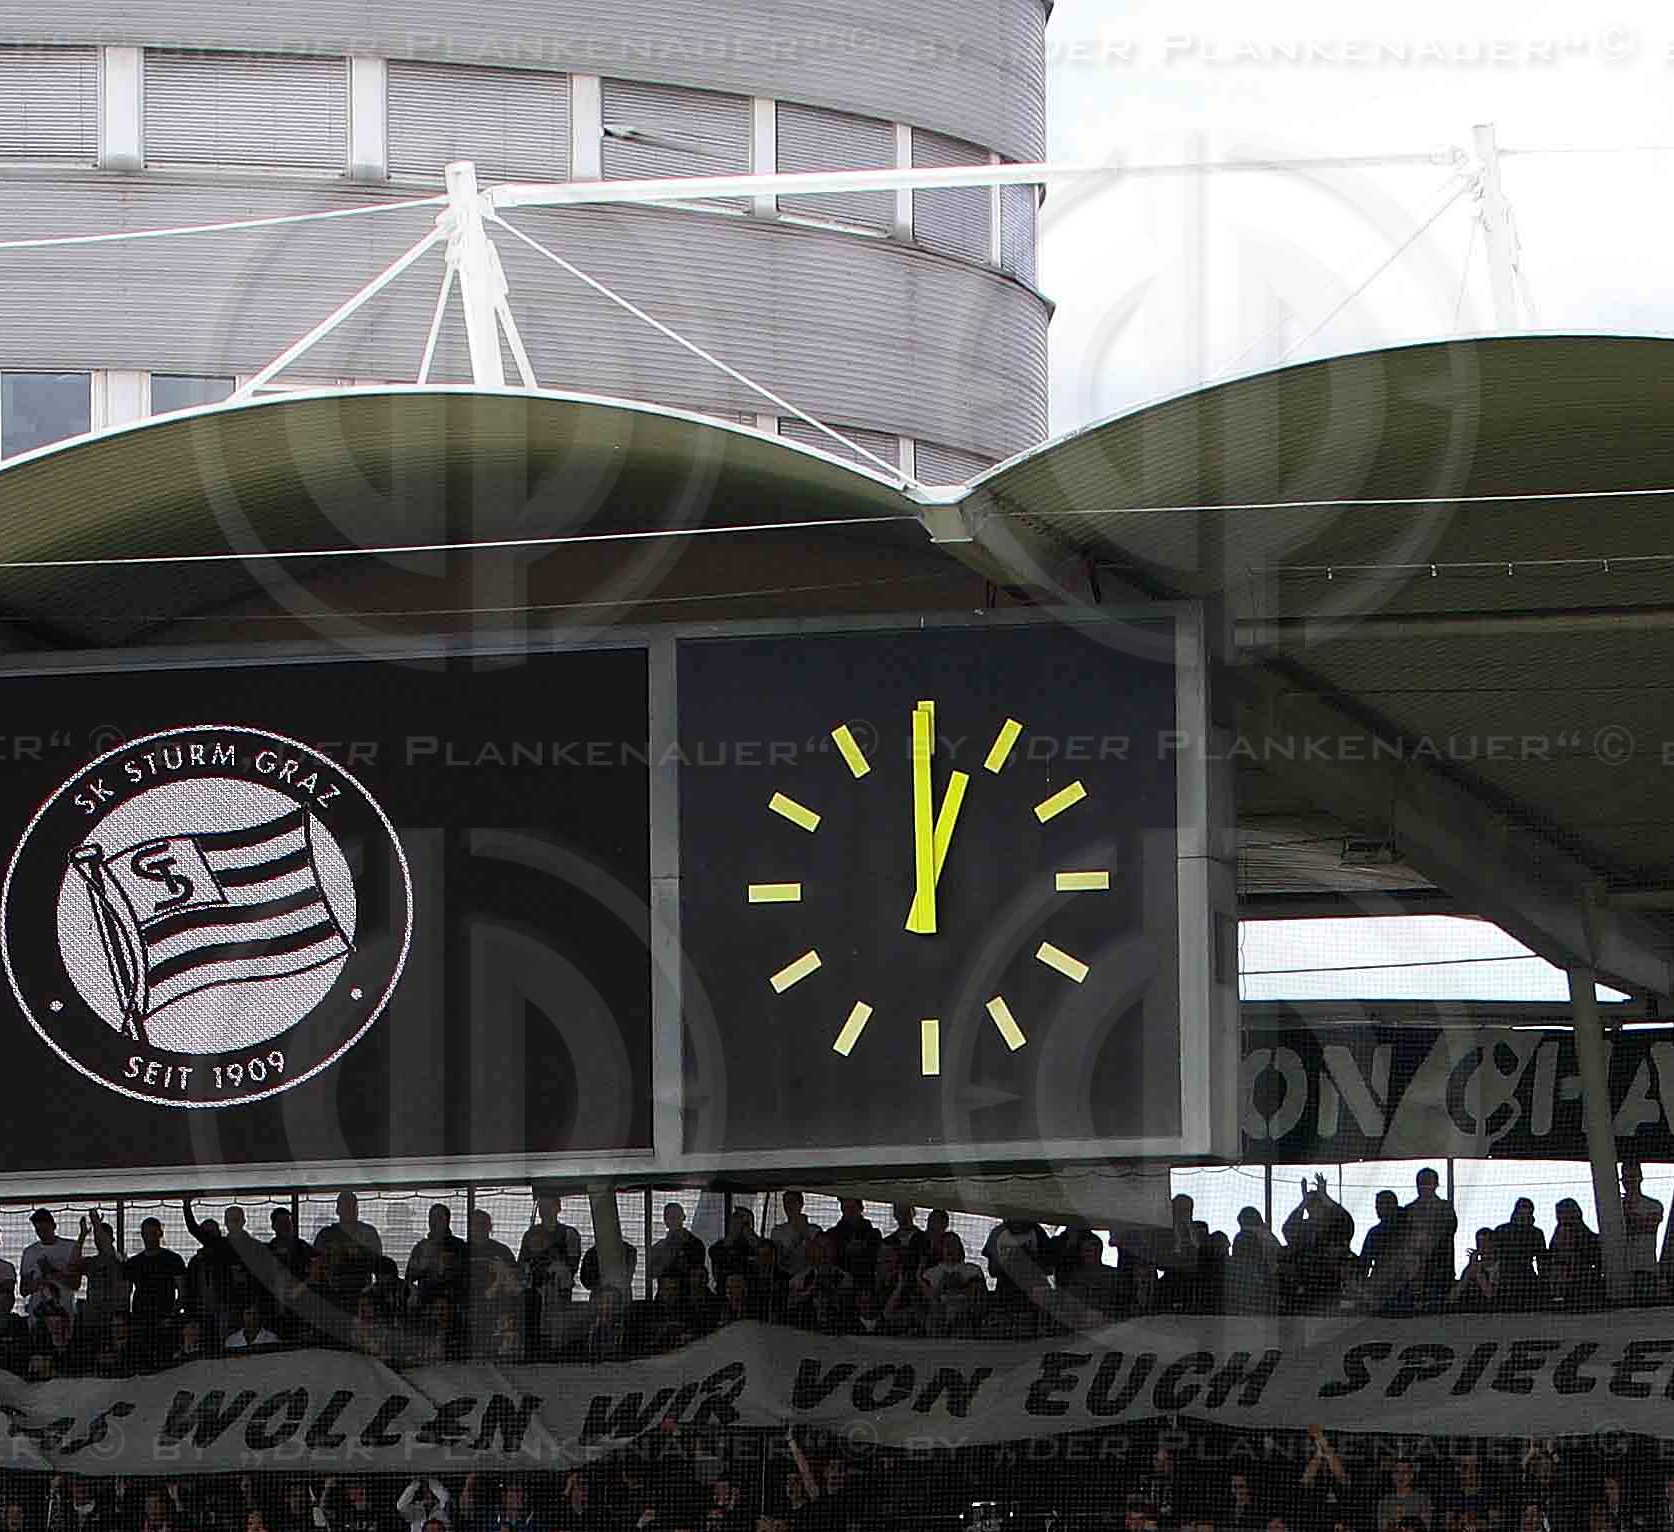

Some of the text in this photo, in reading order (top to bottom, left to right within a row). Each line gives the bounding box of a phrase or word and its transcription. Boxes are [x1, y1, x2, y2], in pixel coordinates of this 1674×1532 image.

[74, 742, 342, 815] SK STURM GRAZ
[124, 1050, 285, 1090] SEIT 1909
[158, 1384, 545, 1454] WOLLEN
[790, 1356, 993, 1419] VON
[1025, 1347, 1283, 1420] EUCH
